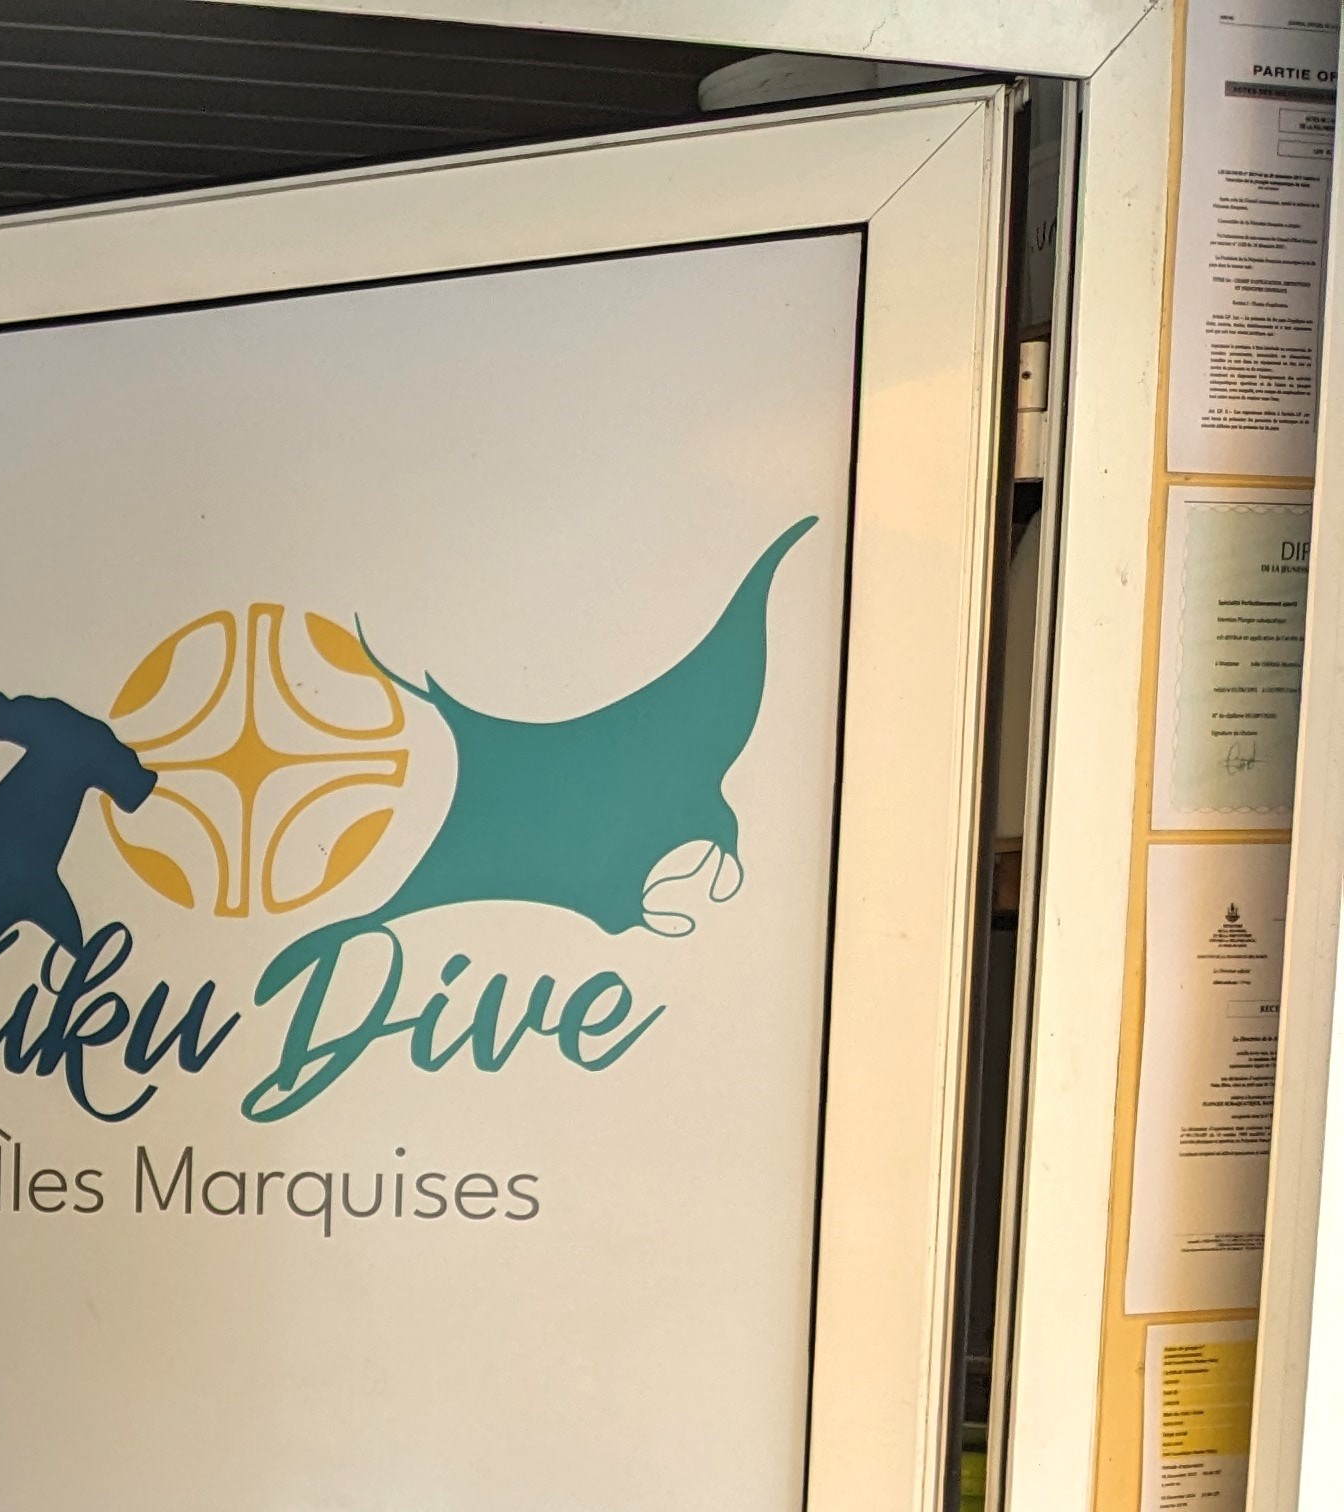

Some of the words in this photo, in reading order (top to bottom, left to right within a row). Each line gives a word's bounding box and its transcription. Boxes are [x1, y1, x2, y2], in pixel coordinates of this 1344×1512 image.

[1253, 64, 1311, 81] PARTIE
[240, 922, 666, 1123] Dive
[135, 1145, 541, 1238] Marquises
